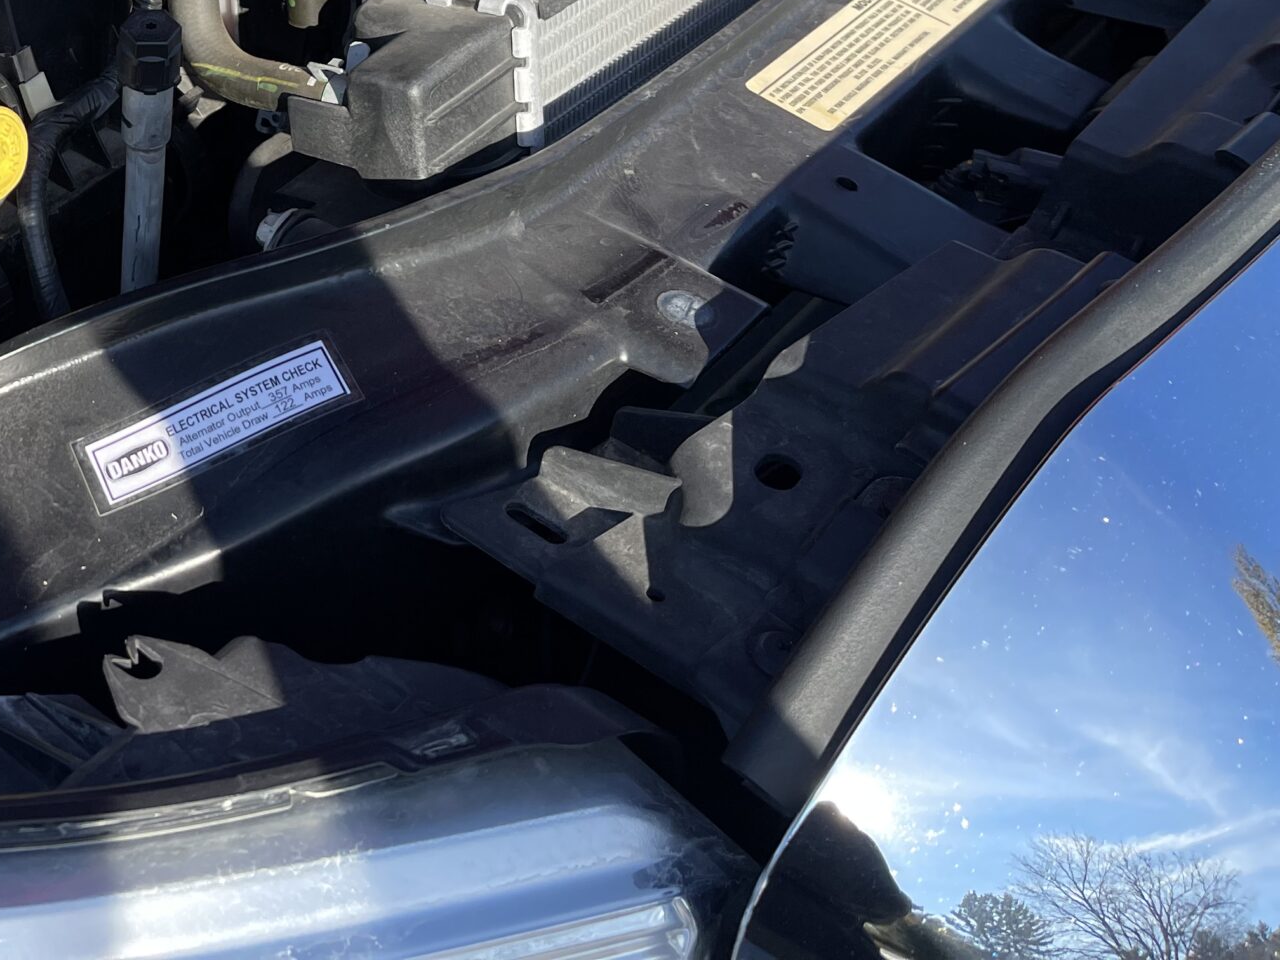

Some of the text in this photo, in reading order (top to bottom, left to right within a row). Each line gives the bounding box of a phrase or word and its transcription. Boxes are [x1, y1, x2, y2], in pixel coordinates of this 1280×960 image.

[166, 357, 324, 437] ELECTRICAL SYSTEM CHECK
[179, 374, 322, 448] Alternator Output 357 Amps
[179, 383, 334, 461] Total Vehicle Draw 122 Amps
[107, 440, 167, 480] DANKO
